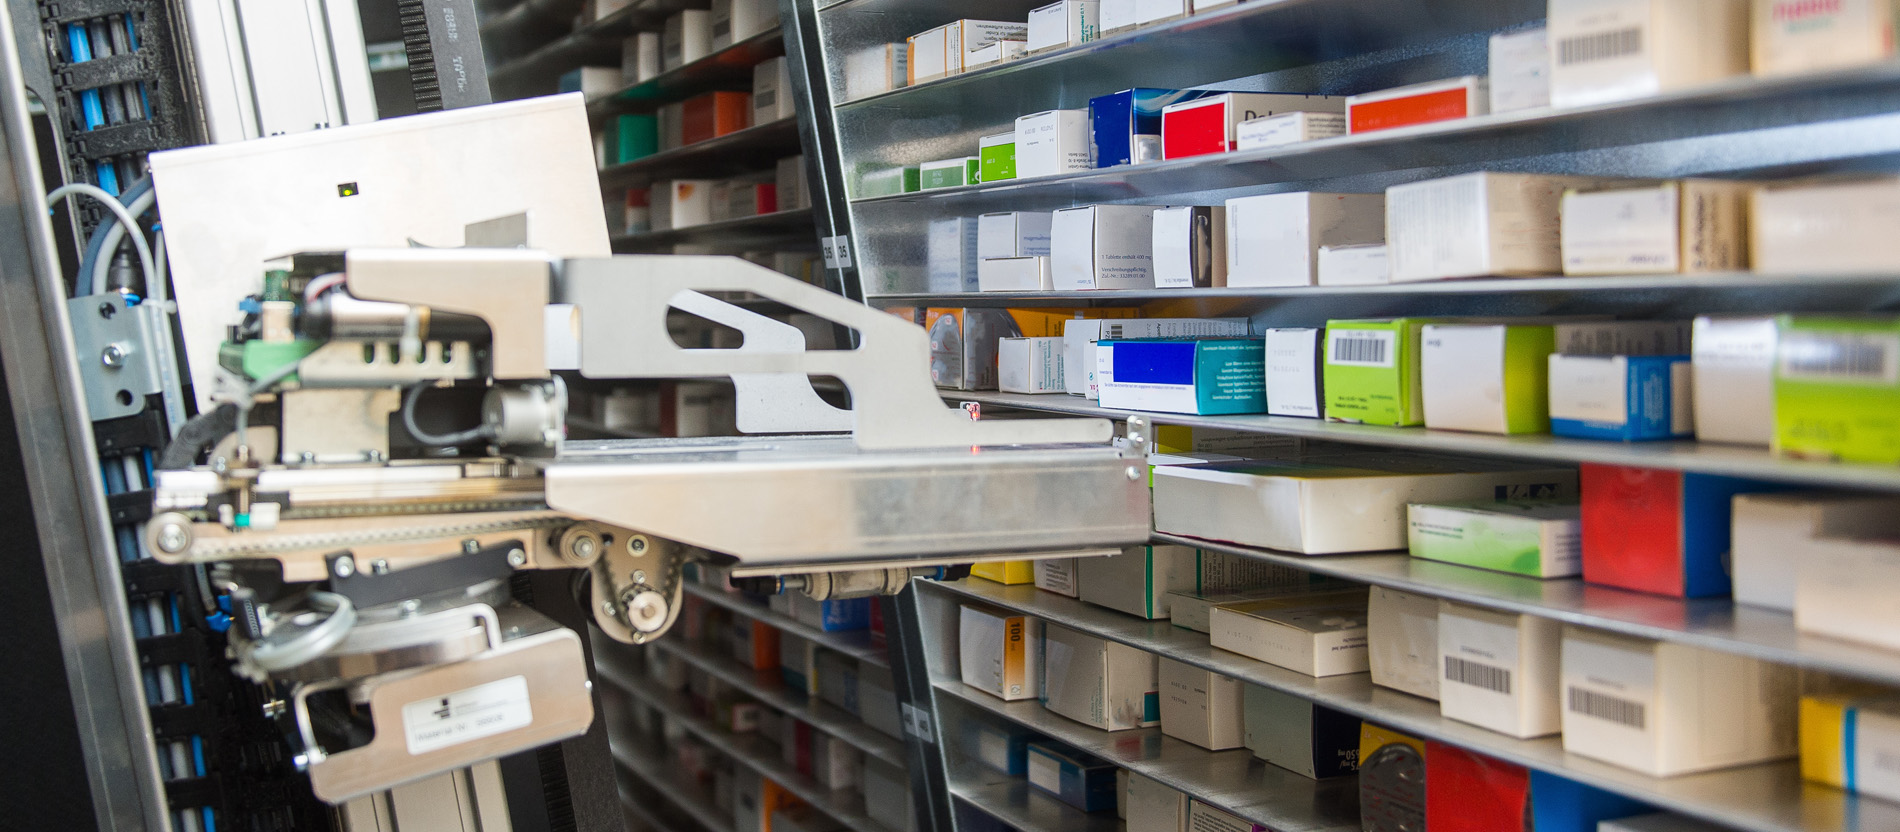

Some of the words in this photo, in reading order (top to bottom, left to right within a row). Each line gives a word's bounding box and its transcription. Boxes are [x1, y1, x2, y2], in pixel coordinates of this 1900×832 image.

[824, 246, 833, 259] 35
[838, 245, 848, 258] 35
[1010, 622, 1021, 642] 100
